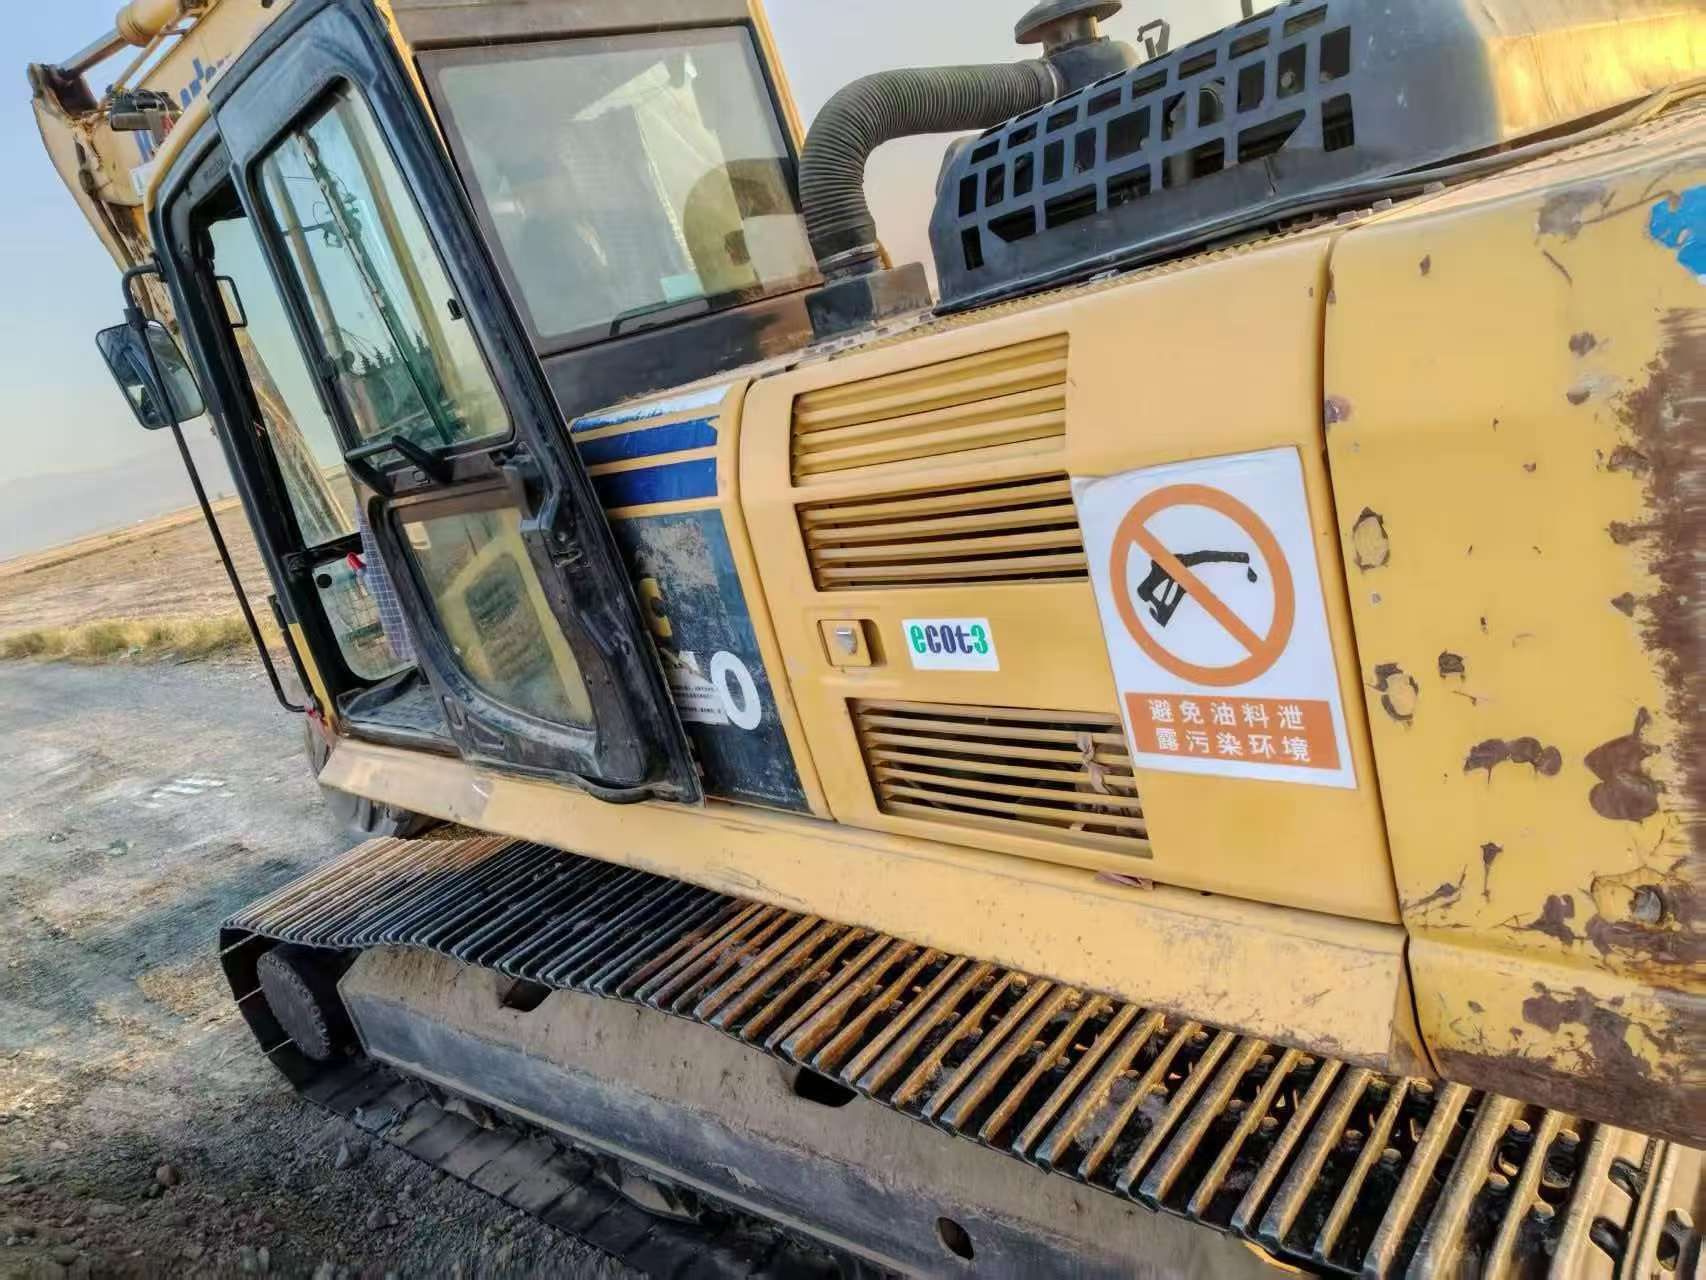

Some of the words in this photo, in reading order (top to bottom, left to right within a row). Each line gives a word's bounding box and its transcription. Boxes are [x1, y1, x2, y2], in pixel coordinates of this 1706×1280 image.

[910, 624, 989, 654] ecot3
[1149, 699, 1305, 731] 避免油料泄
[1155, 727, 1311, 761] 露污染环境
